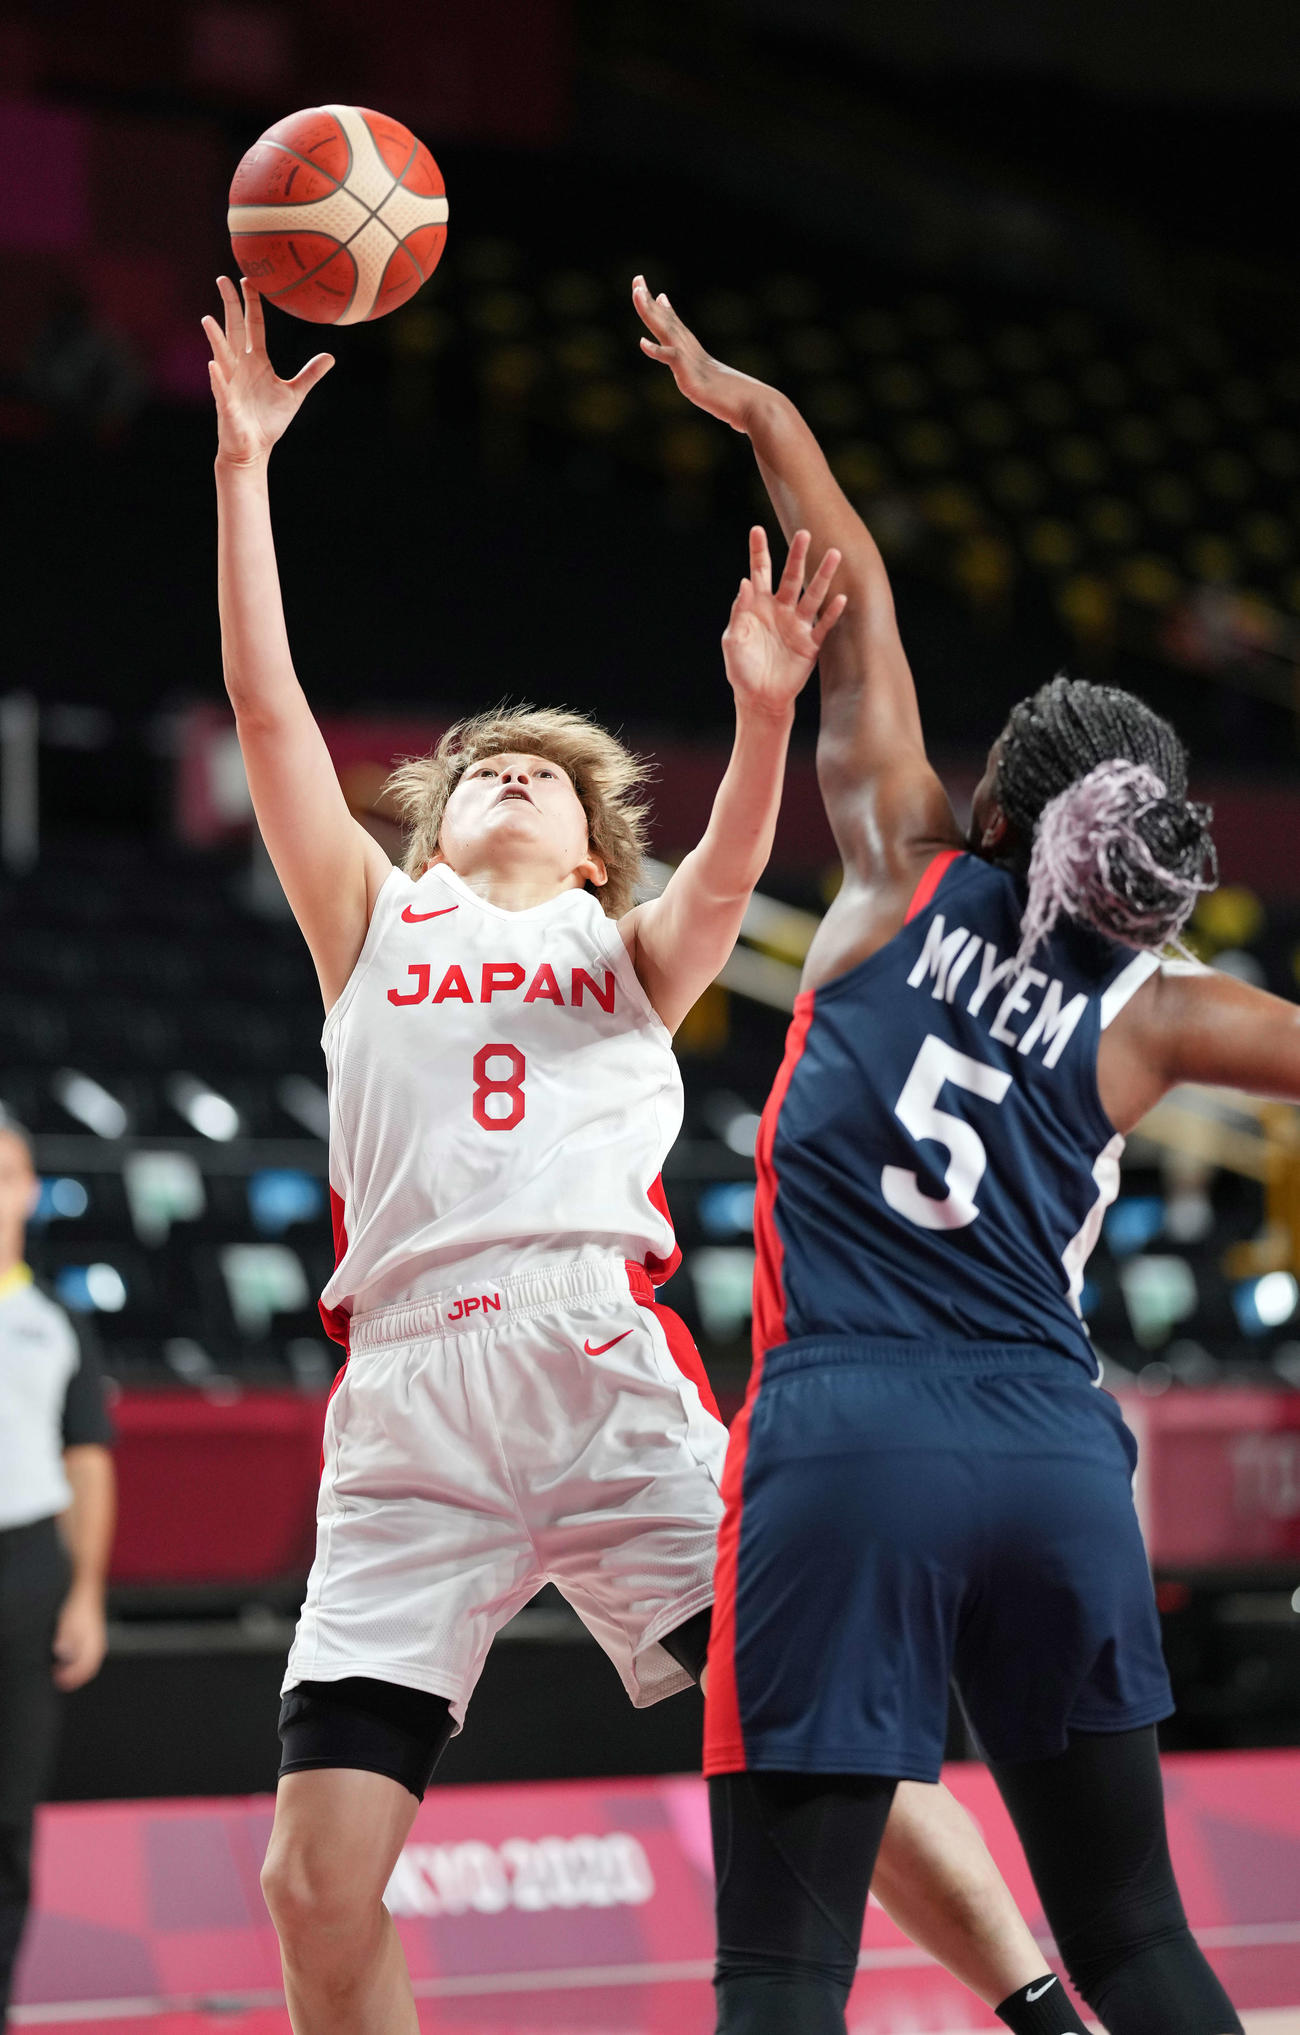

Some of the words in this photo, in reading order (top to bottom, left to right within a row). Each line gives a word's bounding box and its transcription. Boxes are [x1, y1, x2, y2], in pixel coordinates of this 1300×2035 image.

[387, 962, 615, 1014] JAPAN
[907, 914, 1089, 1070] MIYEM
[472, 1043, 526, 1131] 8
[881, 1034, 1013, 1231] 5
[447, 1292, 501, 1321] JPN
